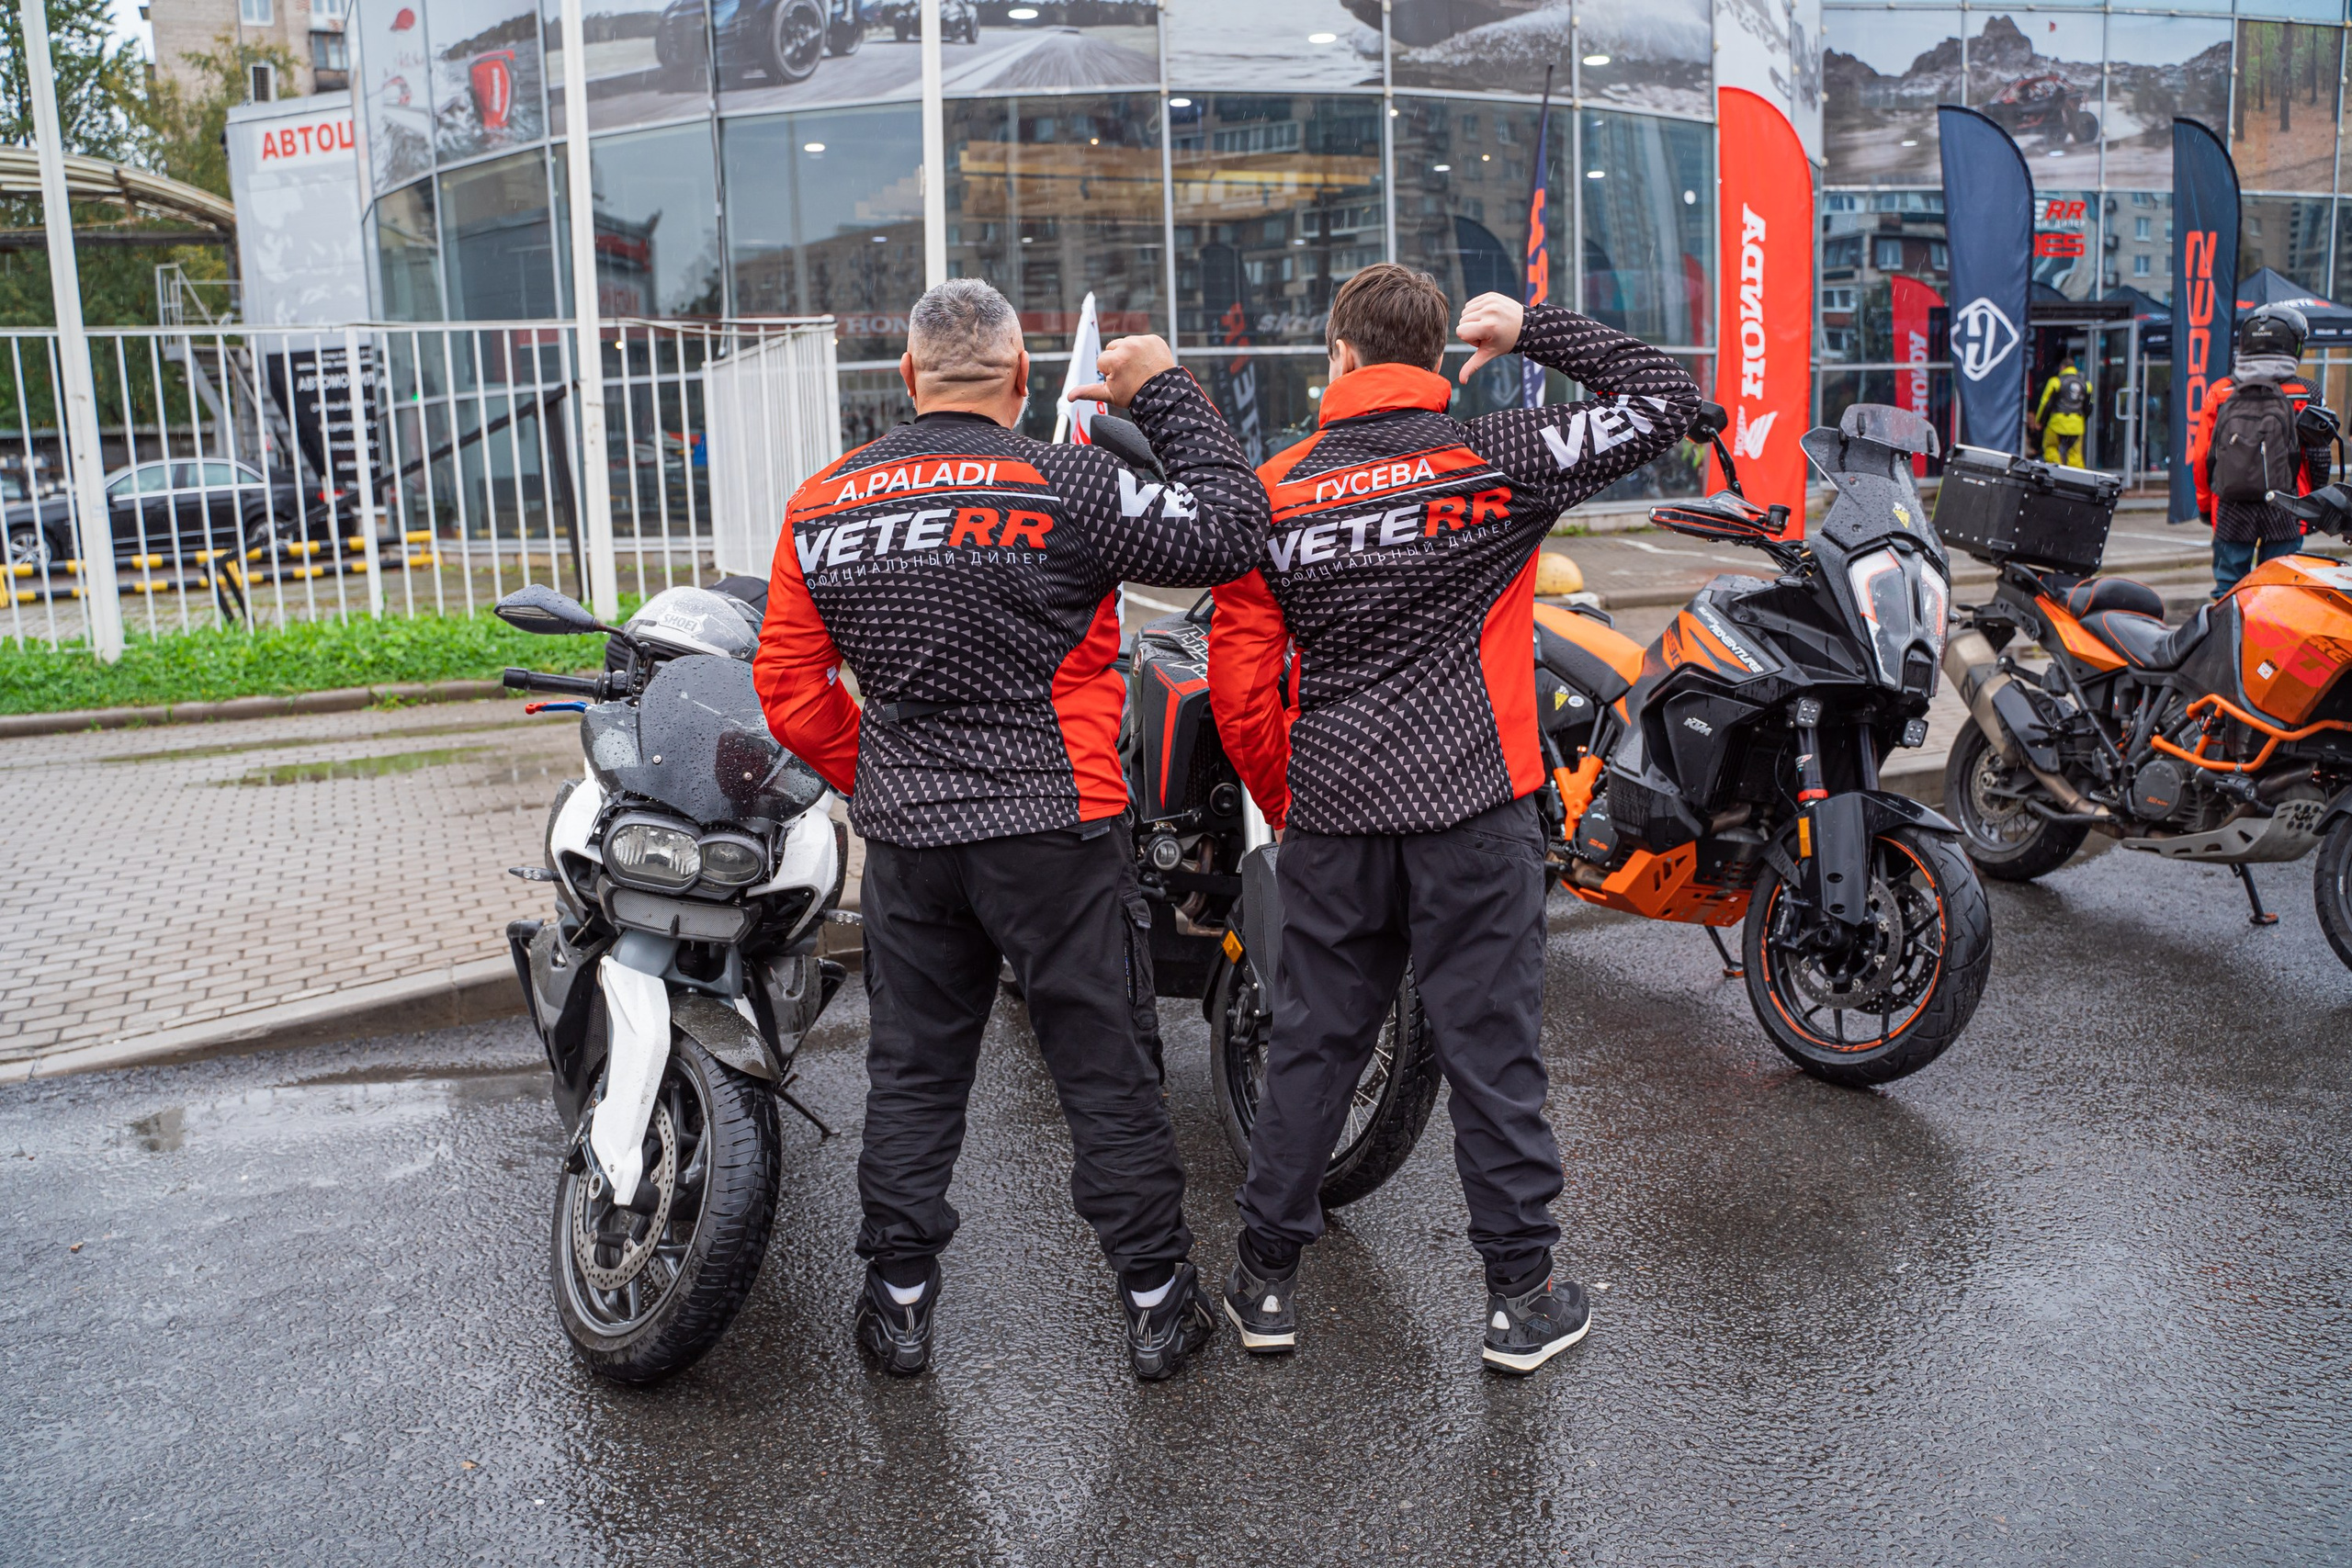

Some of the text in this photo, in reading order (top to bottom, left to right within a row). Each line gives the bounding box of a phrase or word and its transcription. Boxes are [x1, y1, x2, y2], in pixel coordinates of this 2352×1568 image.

[845, 319, 910, 334] HON
[835, 462, 998, 504] A.PALADI
[1316, 458, 1435, 503] ГУСЕВА
[794, 507, 1054, 573] VETERR
[1267, 487, 1512, 572] VETERR
[807, 551, 1049, 591] ОФИЦИАЛЬНЫЙ ДИЛЕР
[1281, 519, 1513, 589] ОФИЦИАЛЬНЫЙ ДИЛЕР
[663, 614, 698, 632] SHOEI
[1709, 624, 1764, 673] ADVENTURE
[1683, 717, 1713, 736] KTM
